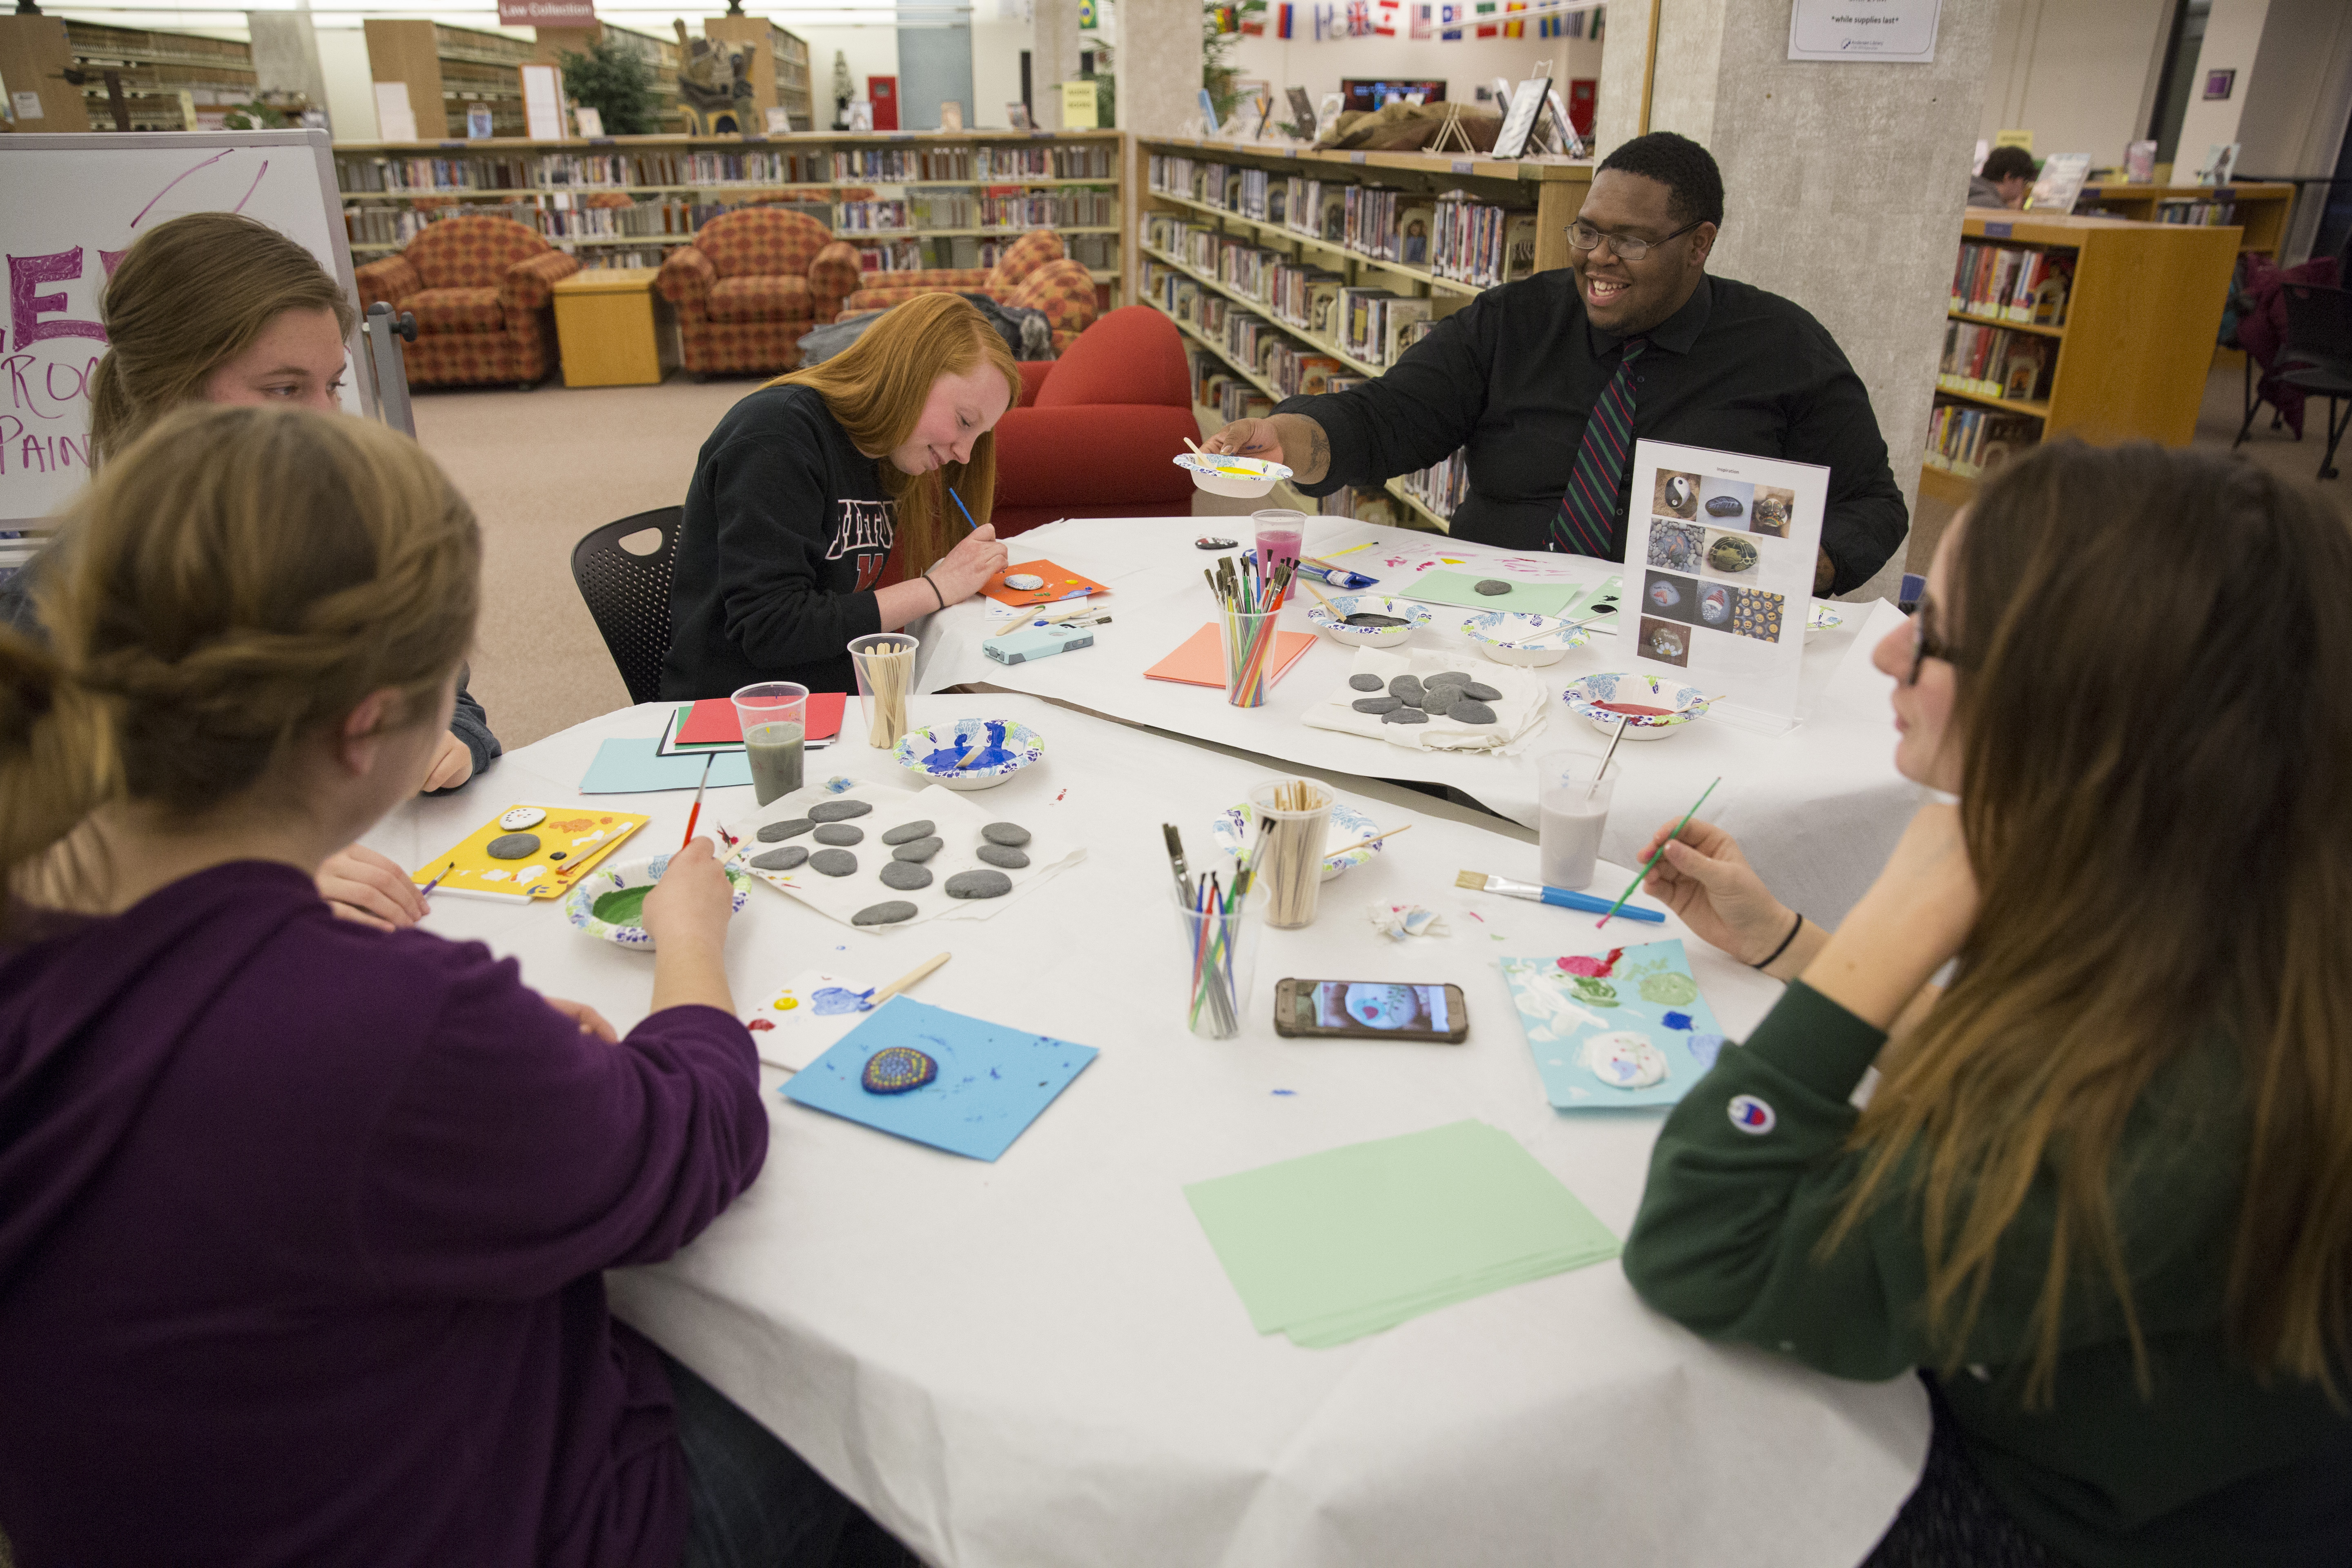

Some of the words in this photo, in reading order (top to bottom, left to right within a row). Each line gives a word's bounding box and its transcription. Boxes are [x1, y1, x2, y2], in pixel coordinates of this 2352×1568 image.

[499, 2, 527, 17] Law
[529, 2, 591, 17] Collection
[1854, 16, 1881, 25] supplies
